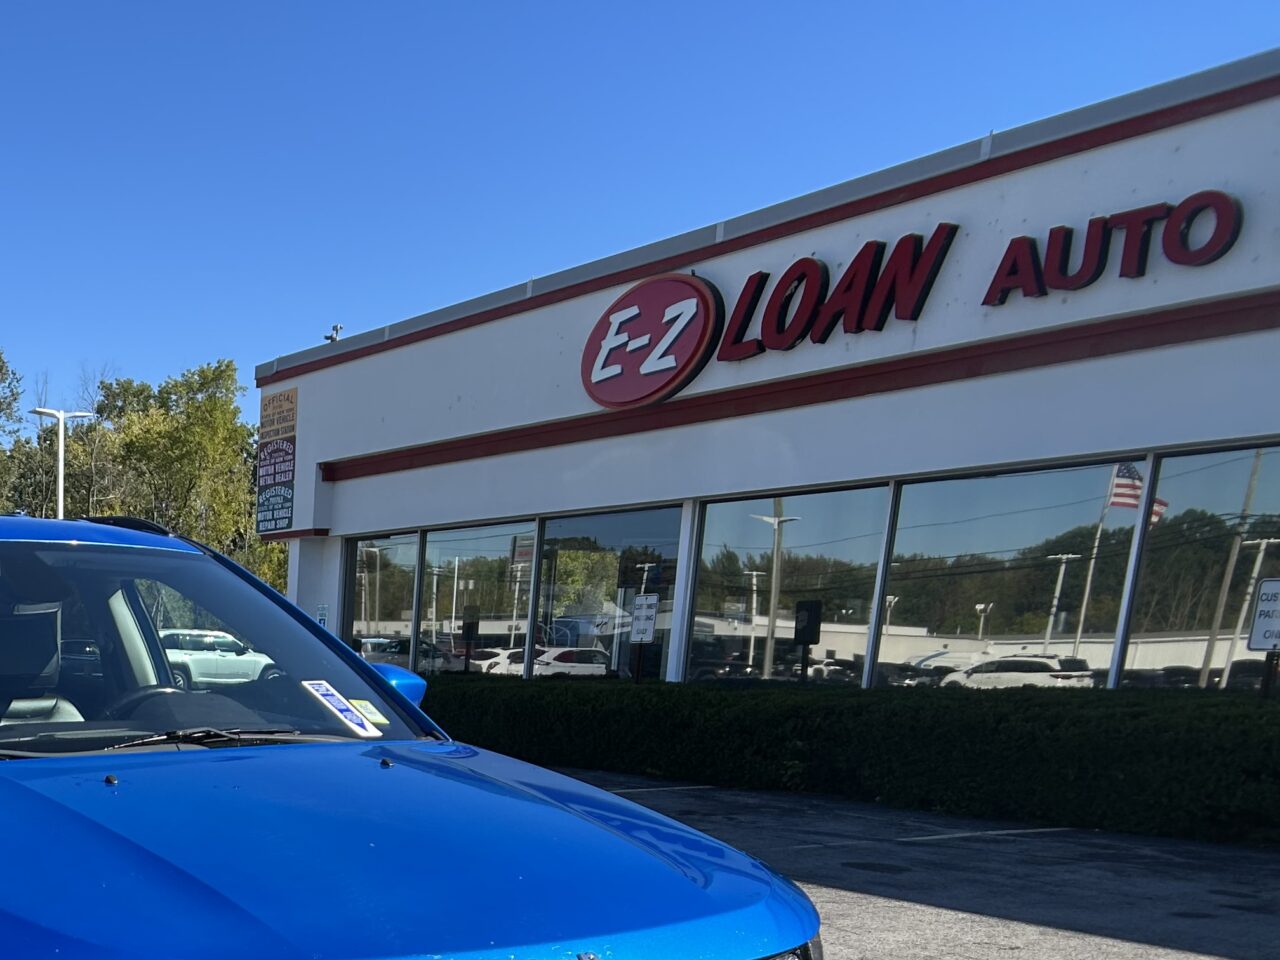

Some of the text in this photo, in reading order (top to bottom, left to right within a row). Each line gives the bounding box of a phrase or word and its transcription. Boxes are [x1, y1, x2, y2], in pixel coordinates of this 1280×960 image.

[980, 189, 1245, 307] AUTO
[590, 222, 961, 384] E-Z LOAN
[263, 393, 294, 411] OFFICIAL
[260, 440, 294, 460] REGISTERED
[275, 460, 294, 472] VEHICLE
[259, 471, 293, 486] RETAIL DEALER
[258, 485, 293, 504] REGISTERED
[257, 507, 292, 522] MOTOR VEHICLE
[259, 517, 289, 531] REPAIR SHOP
